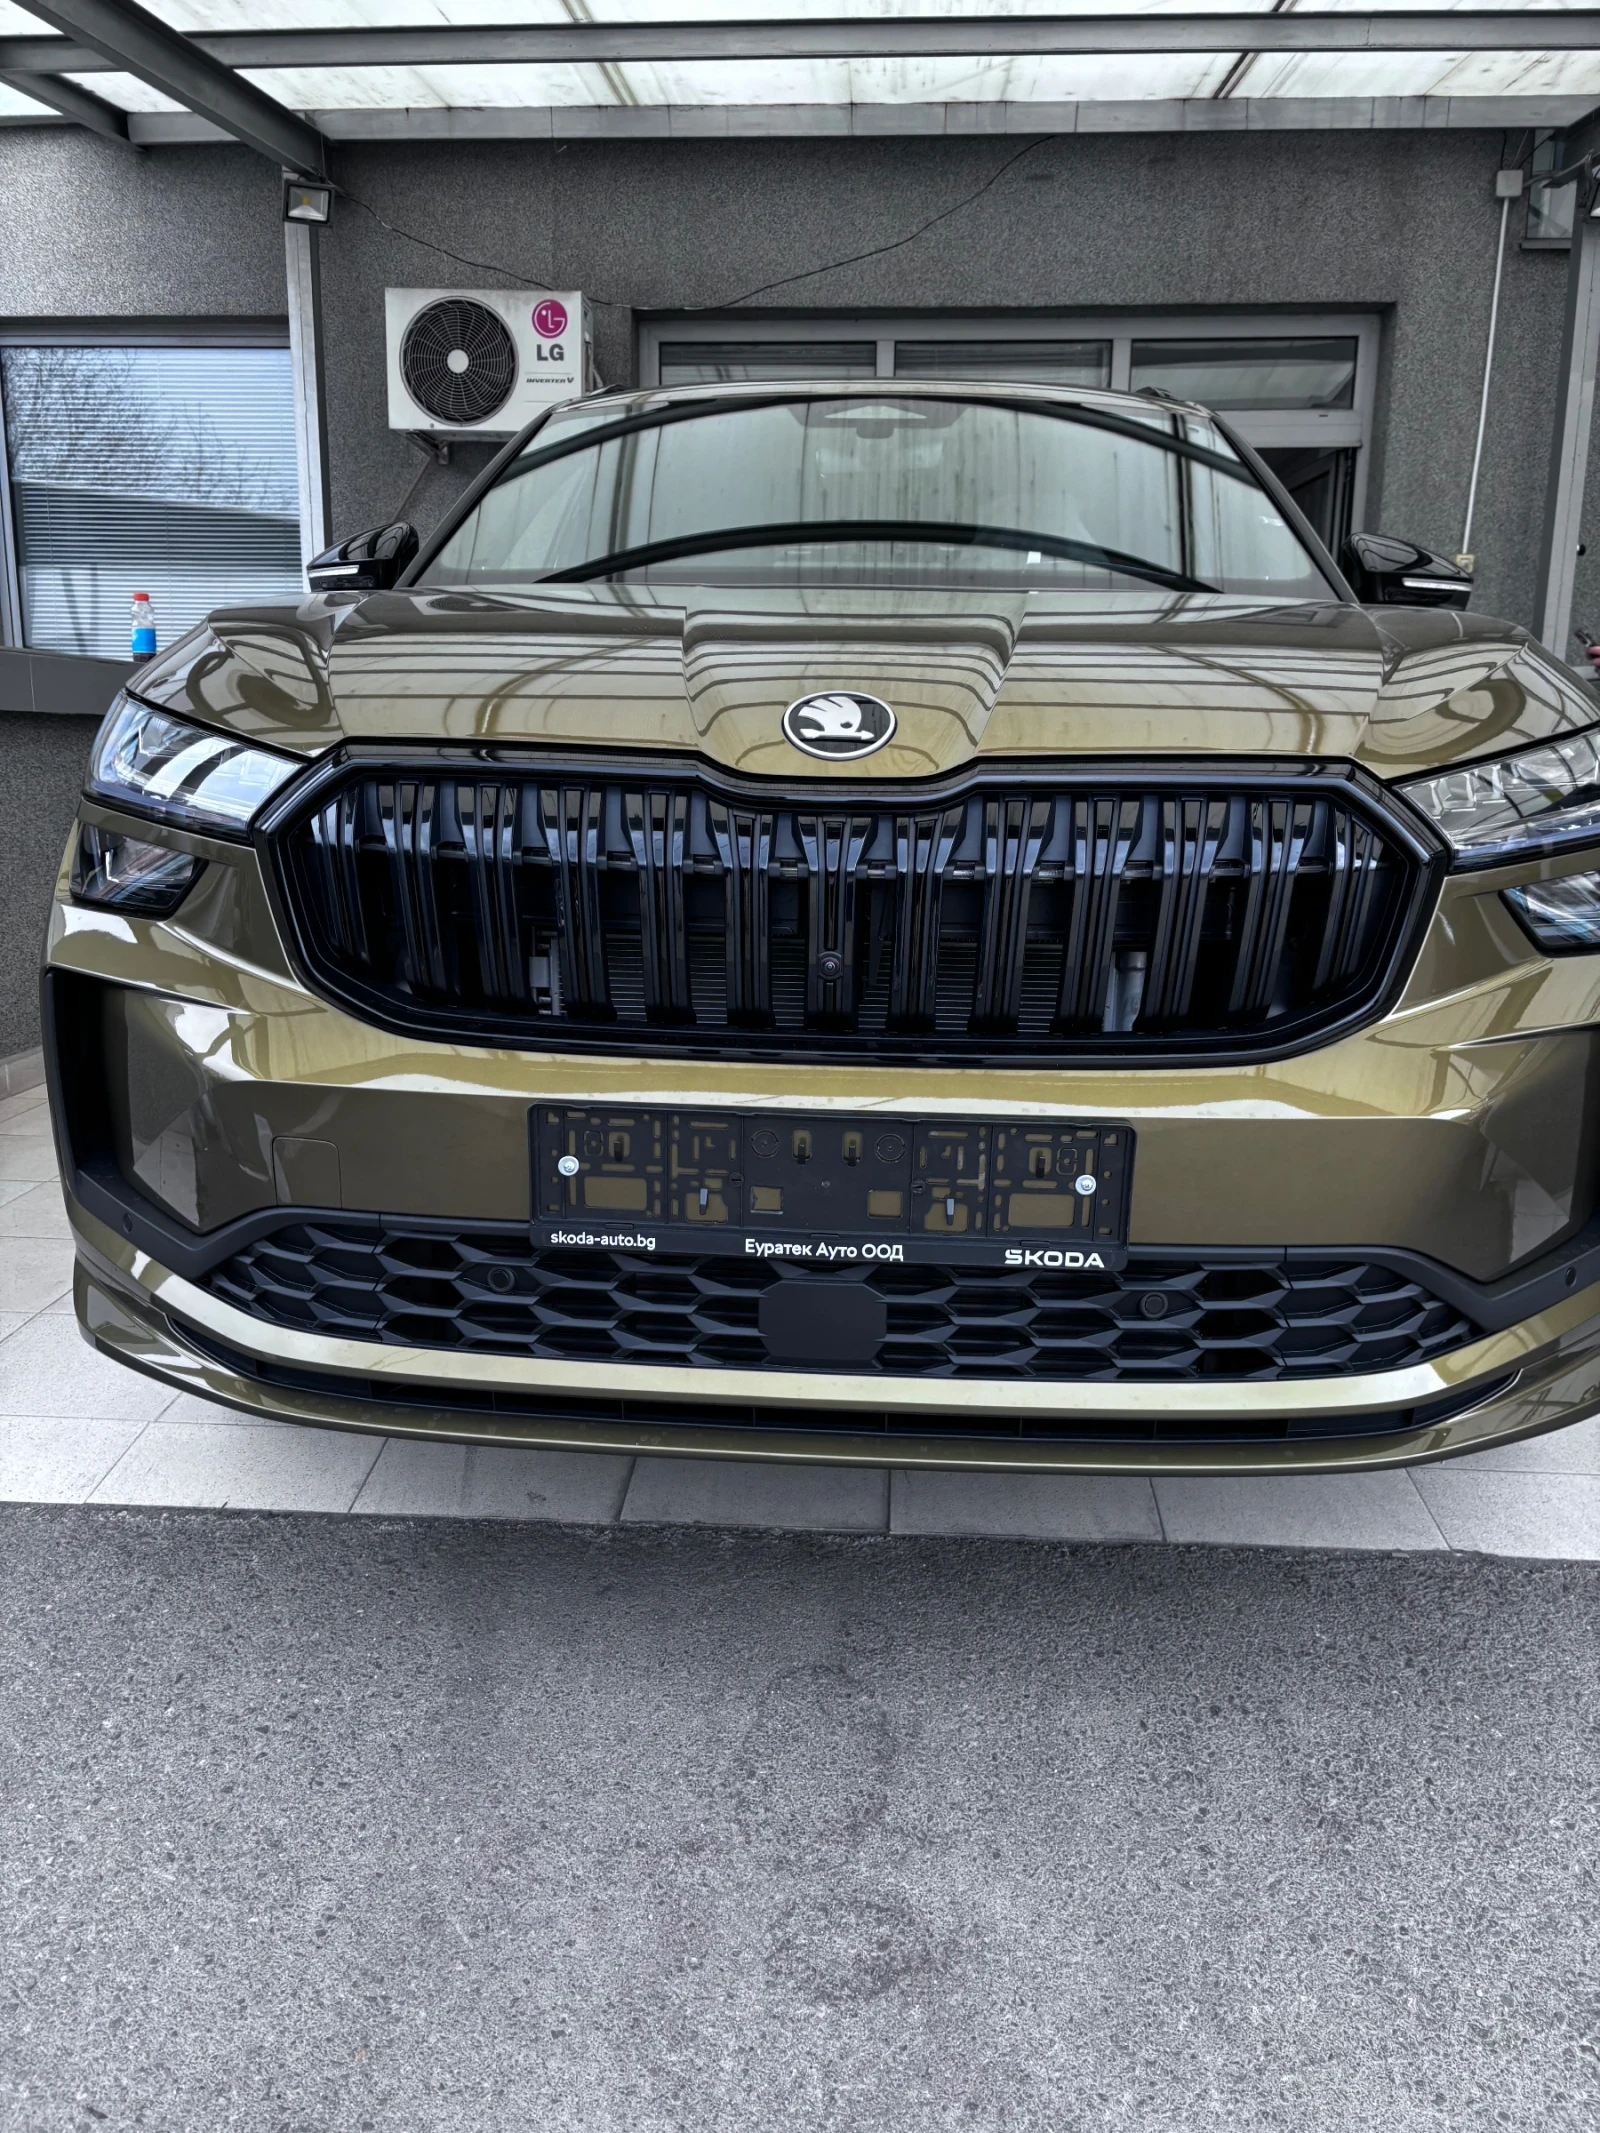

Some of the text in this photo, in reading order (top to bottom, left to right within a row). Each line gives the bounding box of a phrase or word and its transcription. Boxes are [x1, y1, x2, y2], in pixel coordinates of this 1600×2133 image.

[536, 343, 565, 362] LG
[550, 1230, 656, 1251] skoda-auto.bg
[744, 1238, 904, 1262] Еуратек Ауто ООД
